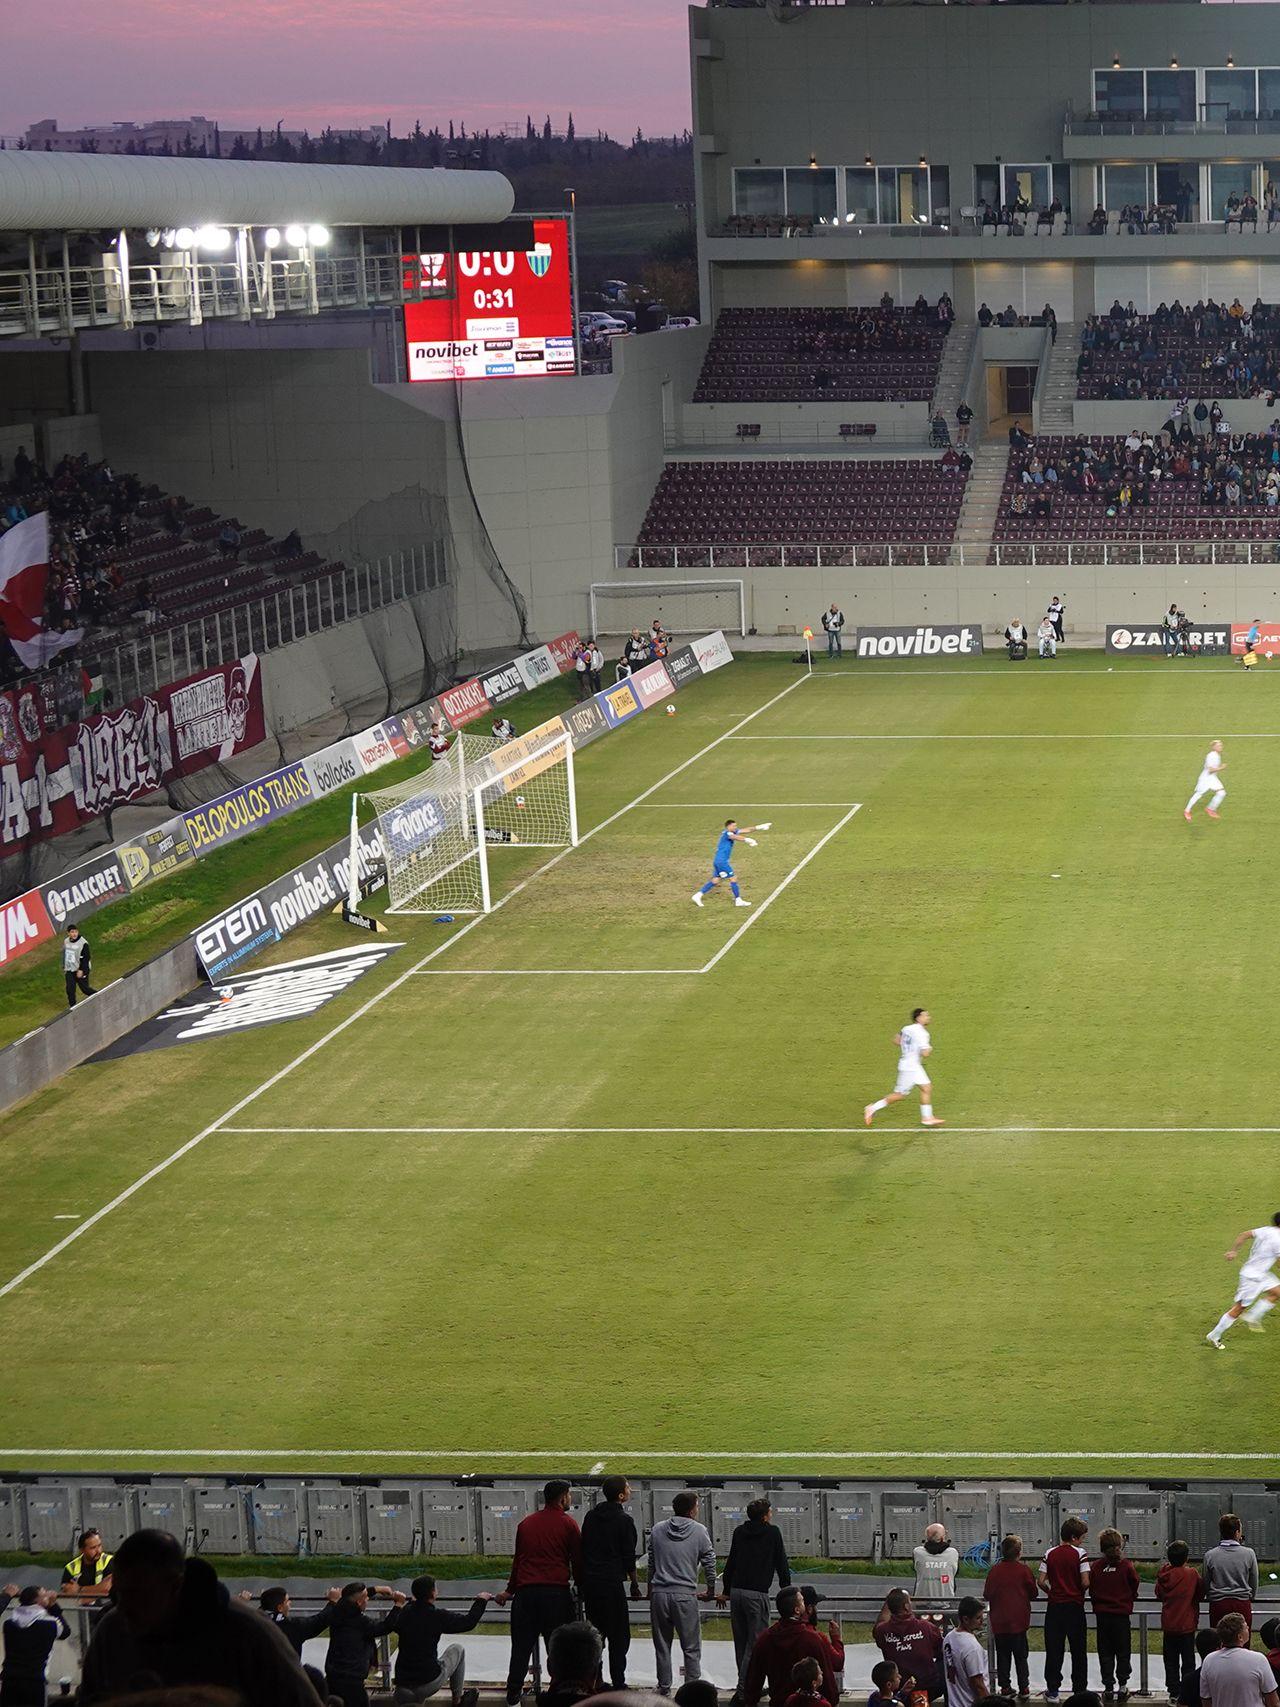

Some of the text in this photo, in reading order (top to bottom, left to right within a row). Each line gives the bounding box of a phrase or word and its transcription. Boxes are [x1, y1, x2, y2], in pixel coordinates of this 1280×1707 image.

[473, 288, 514, 309] 0:31
[416, 342, 478, 359] novibet
[859, 628, 973, 656] novibet
[443, 682, 486, 717] ΦΩΤΑΚΗΣ
[313, 759, 356, 792] bollocks
[185, 767, 312, 849] DELOPOULOS TRANS
[60, 864, 123, 912] ZAKCRET
[270, 863, 337, 934] novibet
[195, 898, 267, 964] ETEM
[925, 1561, 948, 1569] STAFF
